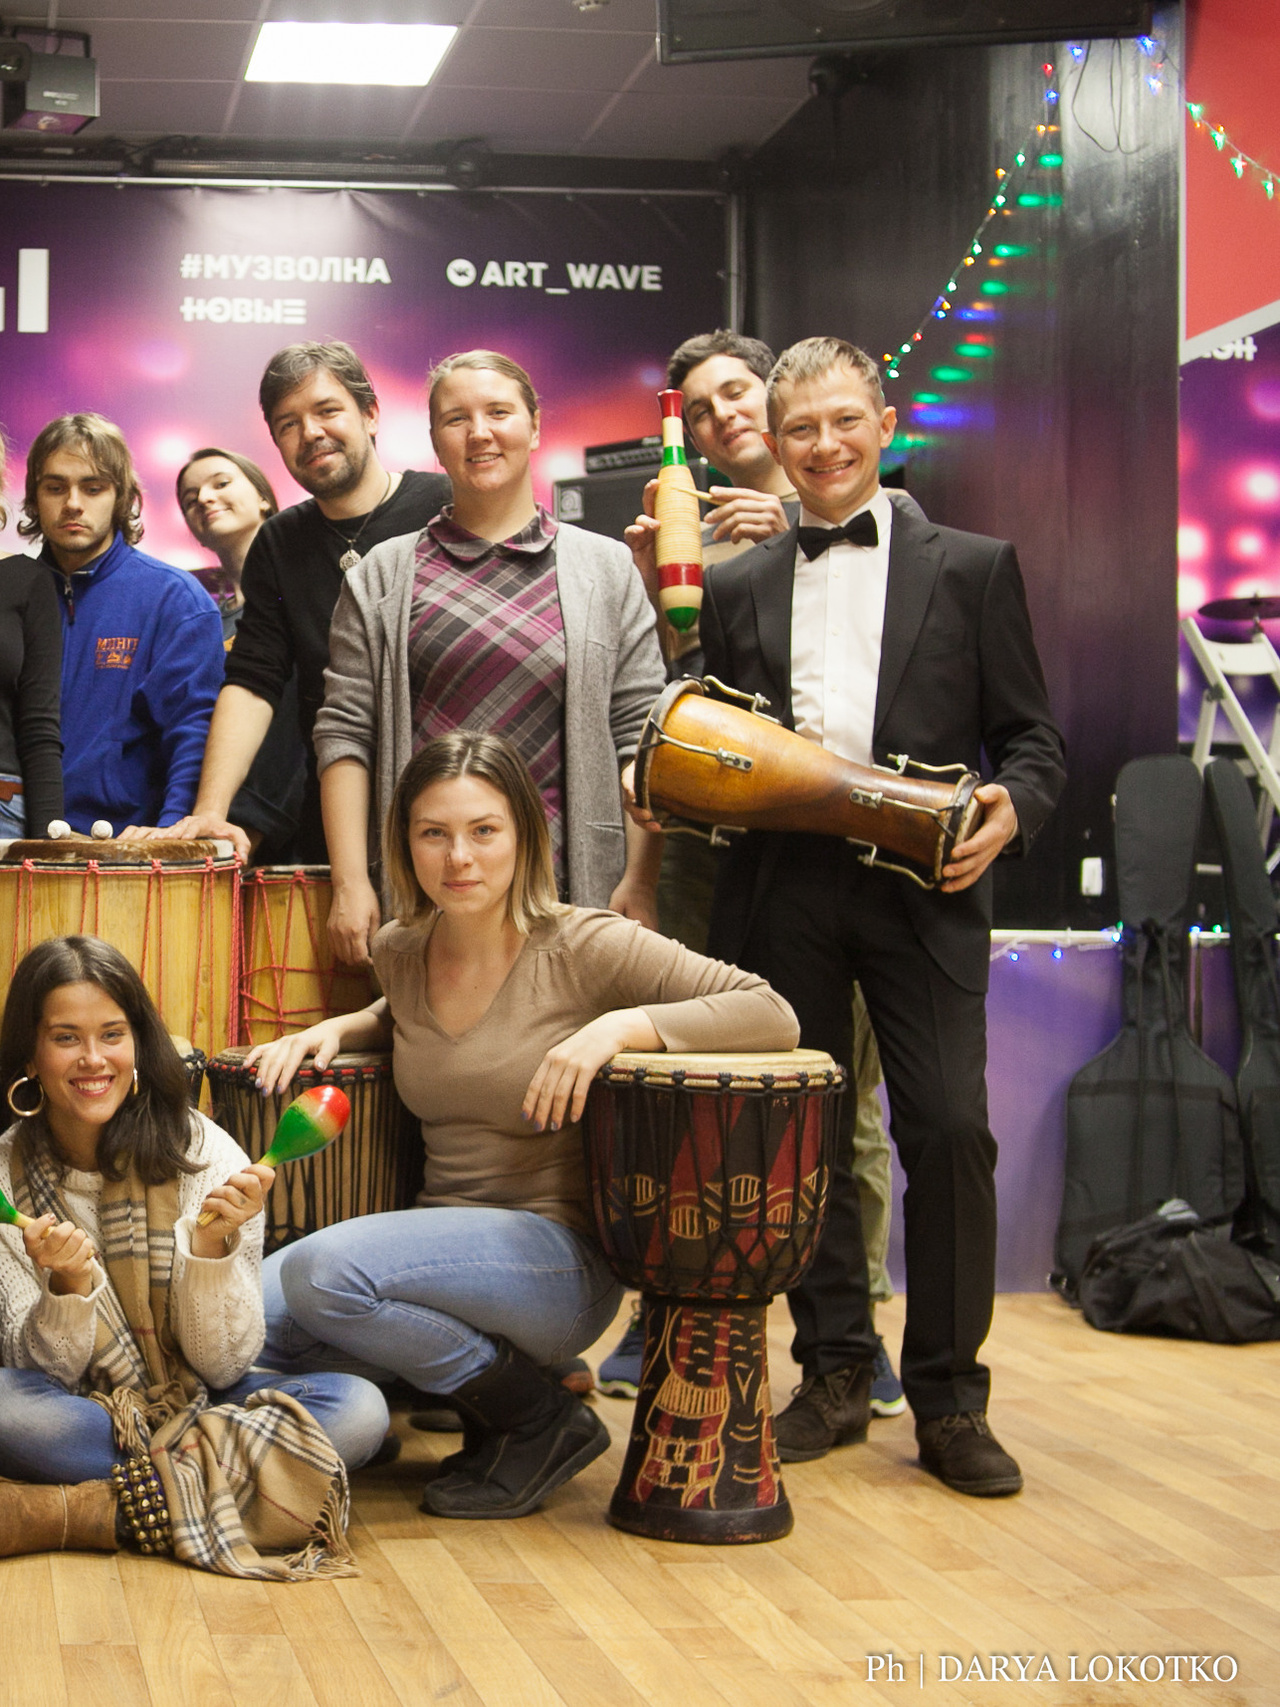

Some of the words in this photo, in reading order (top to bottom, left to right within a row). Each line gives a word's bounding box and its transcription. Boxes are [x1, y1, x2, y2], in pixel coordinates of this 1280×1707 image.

[180, 253, 392, 285] #МУЗВОЛНА
[480, 260, 663, 295] ART_WAVE
[179, 296, 307, 325] НОВЫЕ
